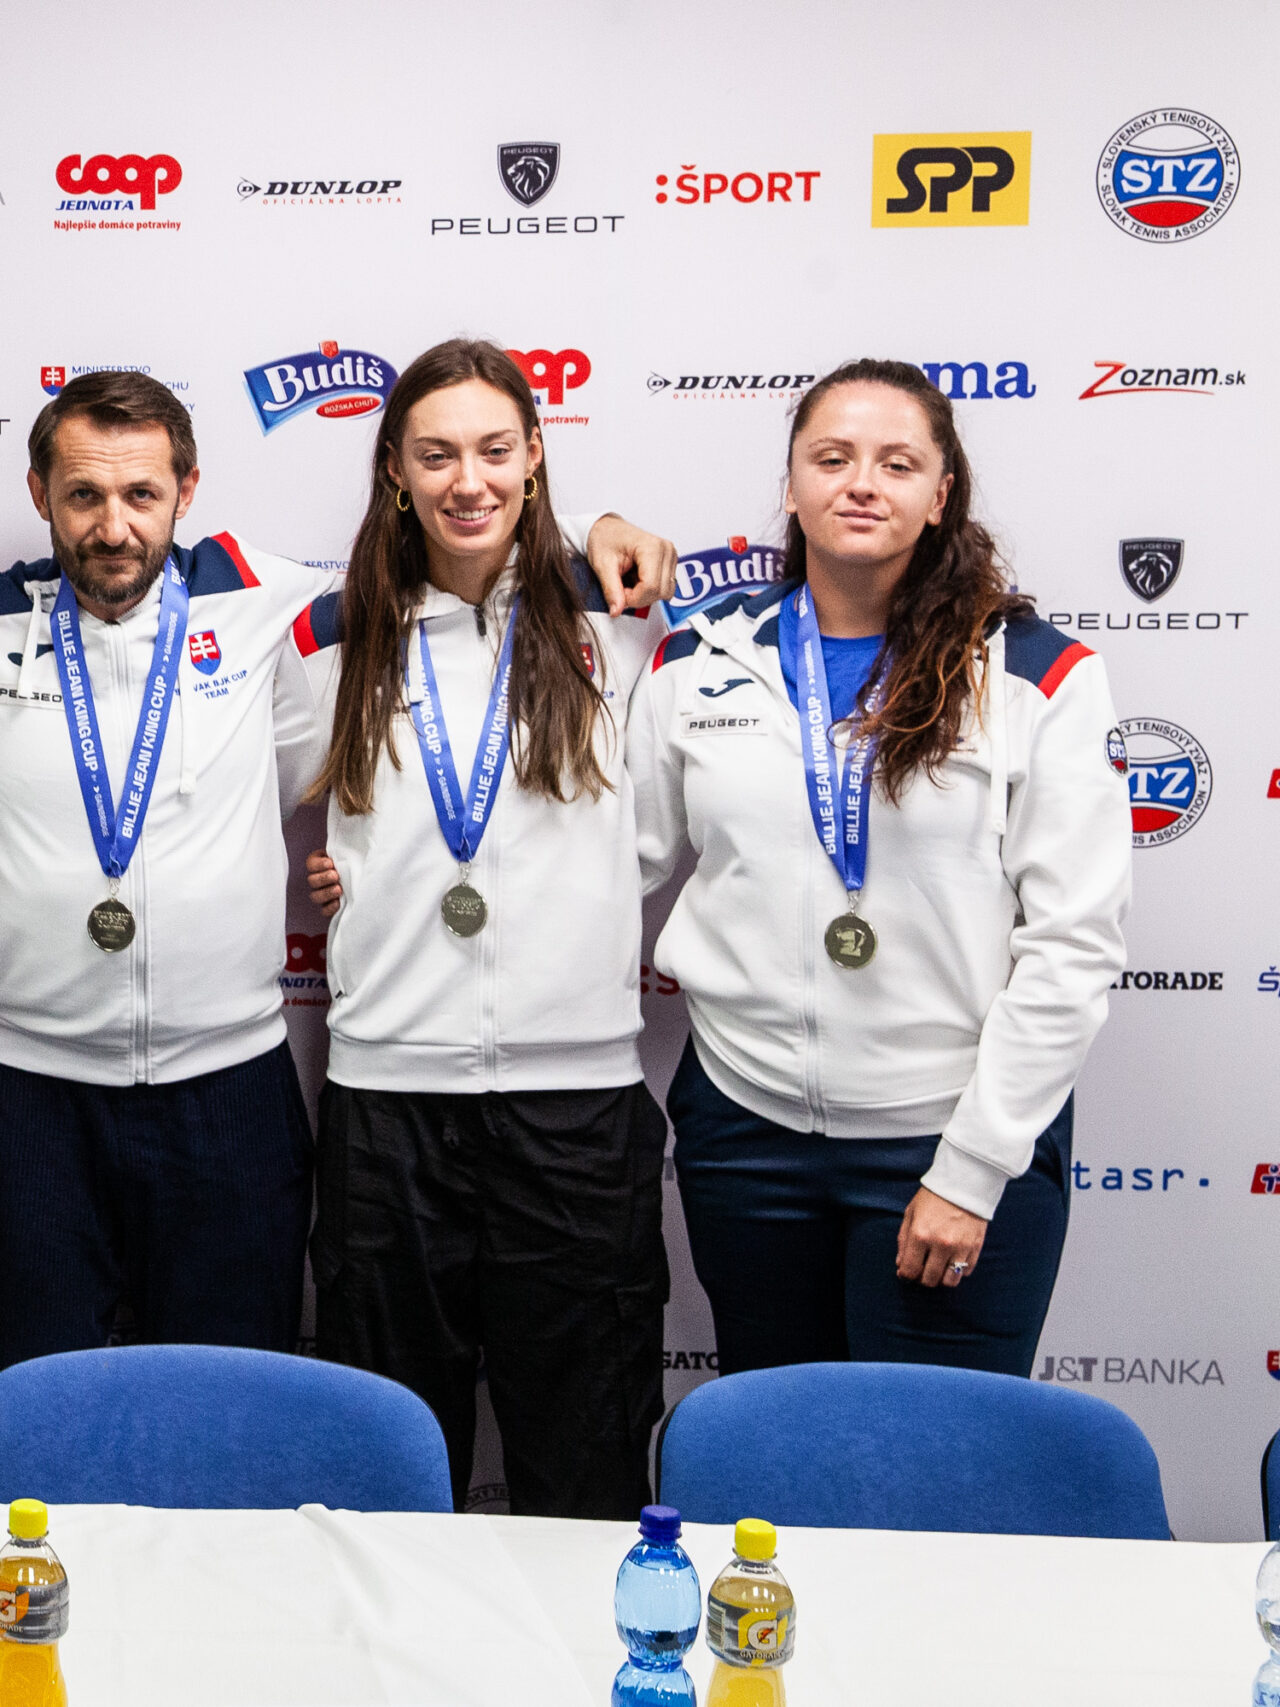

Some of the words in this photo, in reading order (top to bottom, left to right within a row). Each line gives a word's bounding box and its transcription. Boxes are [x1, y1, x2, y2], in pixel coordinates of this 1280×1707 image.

[1102, 112, 1157, 169] SLOVENSKÝ
[1163, 112, 1220, 138] TENISOVÝ
[264, 180, 402, 195] DUNLOP
[886, 146, 1015, 214] SPP
[1120, 158, 1217, 193] STZ
[55, 200, 135, 211] JEDNOTA
[262, 197, 344, 205] OFICIÁLNA
[356, 196, 402, 204] LOPTA
[1101, 184, 1128, 226] SLOVAK
[1130, 221, 1170, 239] TENNIS
[1174, 182, 1234, 239] ASSOCIATION
[54, 220, 96, 231] Najlepšie
[98, 220, 134, 230] domáce
[136, 220, 181, 231] potraviny
[432, 216, 625, 235] PEUGEOT
[163, 381, 189, 390] CHU
[263, 354, 385, 413] Budiš
[674, 374, 815, 389] DUNLOP
[922, 361, 1036, 399] ma
[1078, 361, 1246, 400] Zoznam.sk
[543, 415, 589, 425] potraviny
[57, 610, 76, 656] BILLIE
[1048, 612, 1249, 630] PEUGEOT
[65, 657, 84, 698] JEAN
[151, 675, 167, 710] CUP
[231, 669, 248, 682] CUP
[204, 687, 229, 700] TEAM
[807, 696, 824, 724] CUP
[73, 698, 91, 739] KING
[142, 709, 162, 750] KING
[689, 718, 760, 731] PEUGEOT
[1136, 722, 1193, 747] TENISOVÝ
[81, 738, 99, 771] CUP
[424, 722, 442, 756] CUP
[810, 724, 829, 763] KING
[133, 748, 153, 792] JEAN
[471, 774, 493, 823] BILLIE
[482, 733, 504, 776] JEAN
[814, 763, 832, 805] JEAN
[1129, 767, 1190, 799] TZ
[122, 790, 143, 839] BILLIE
[820, 806, 836, 854] BILLIE
[846, 795, 860, 845] BILLIE
[1149, 790, 1207, 844] ASSOCIATION
[1110, 971, 1223, 990] TORADE
[1038, 1356, 1097, 1382] J&T
[1104, 1358, 1224, 1386] BANKA
